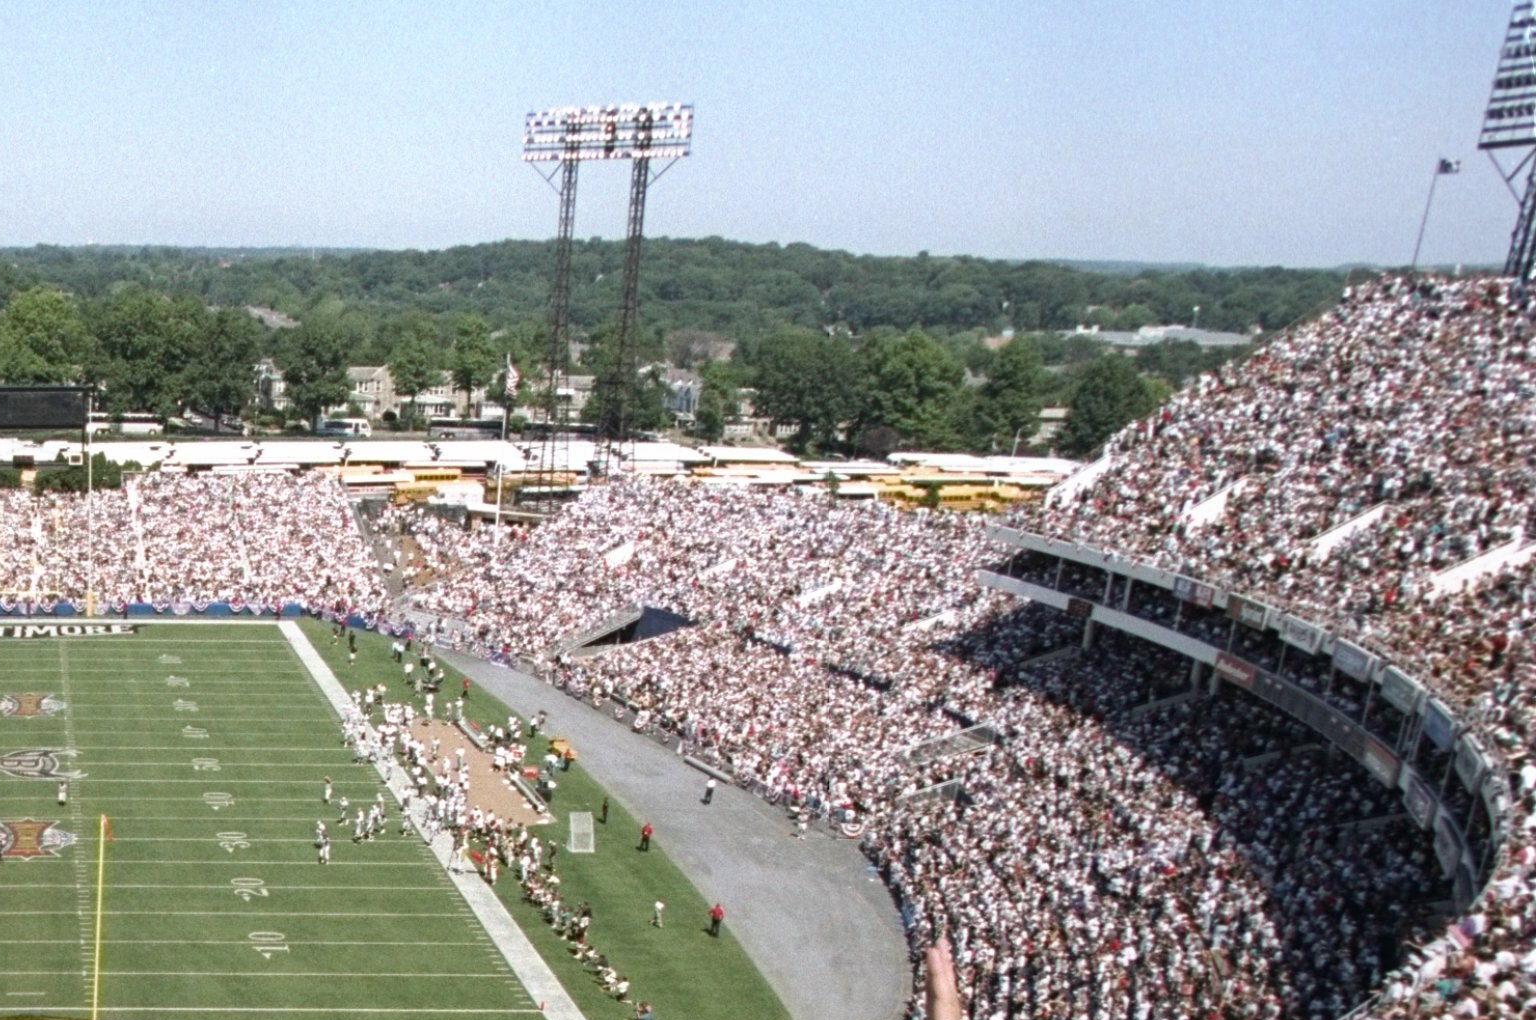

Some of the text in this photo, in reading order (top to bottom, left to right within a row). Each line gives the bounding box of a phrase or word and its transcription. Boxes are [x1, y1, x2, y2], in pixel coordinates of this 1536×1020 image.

[216, 832, 251, 849] 30
[230, 878, 269, 896] 20
[248, 932, 290, 953] 10
